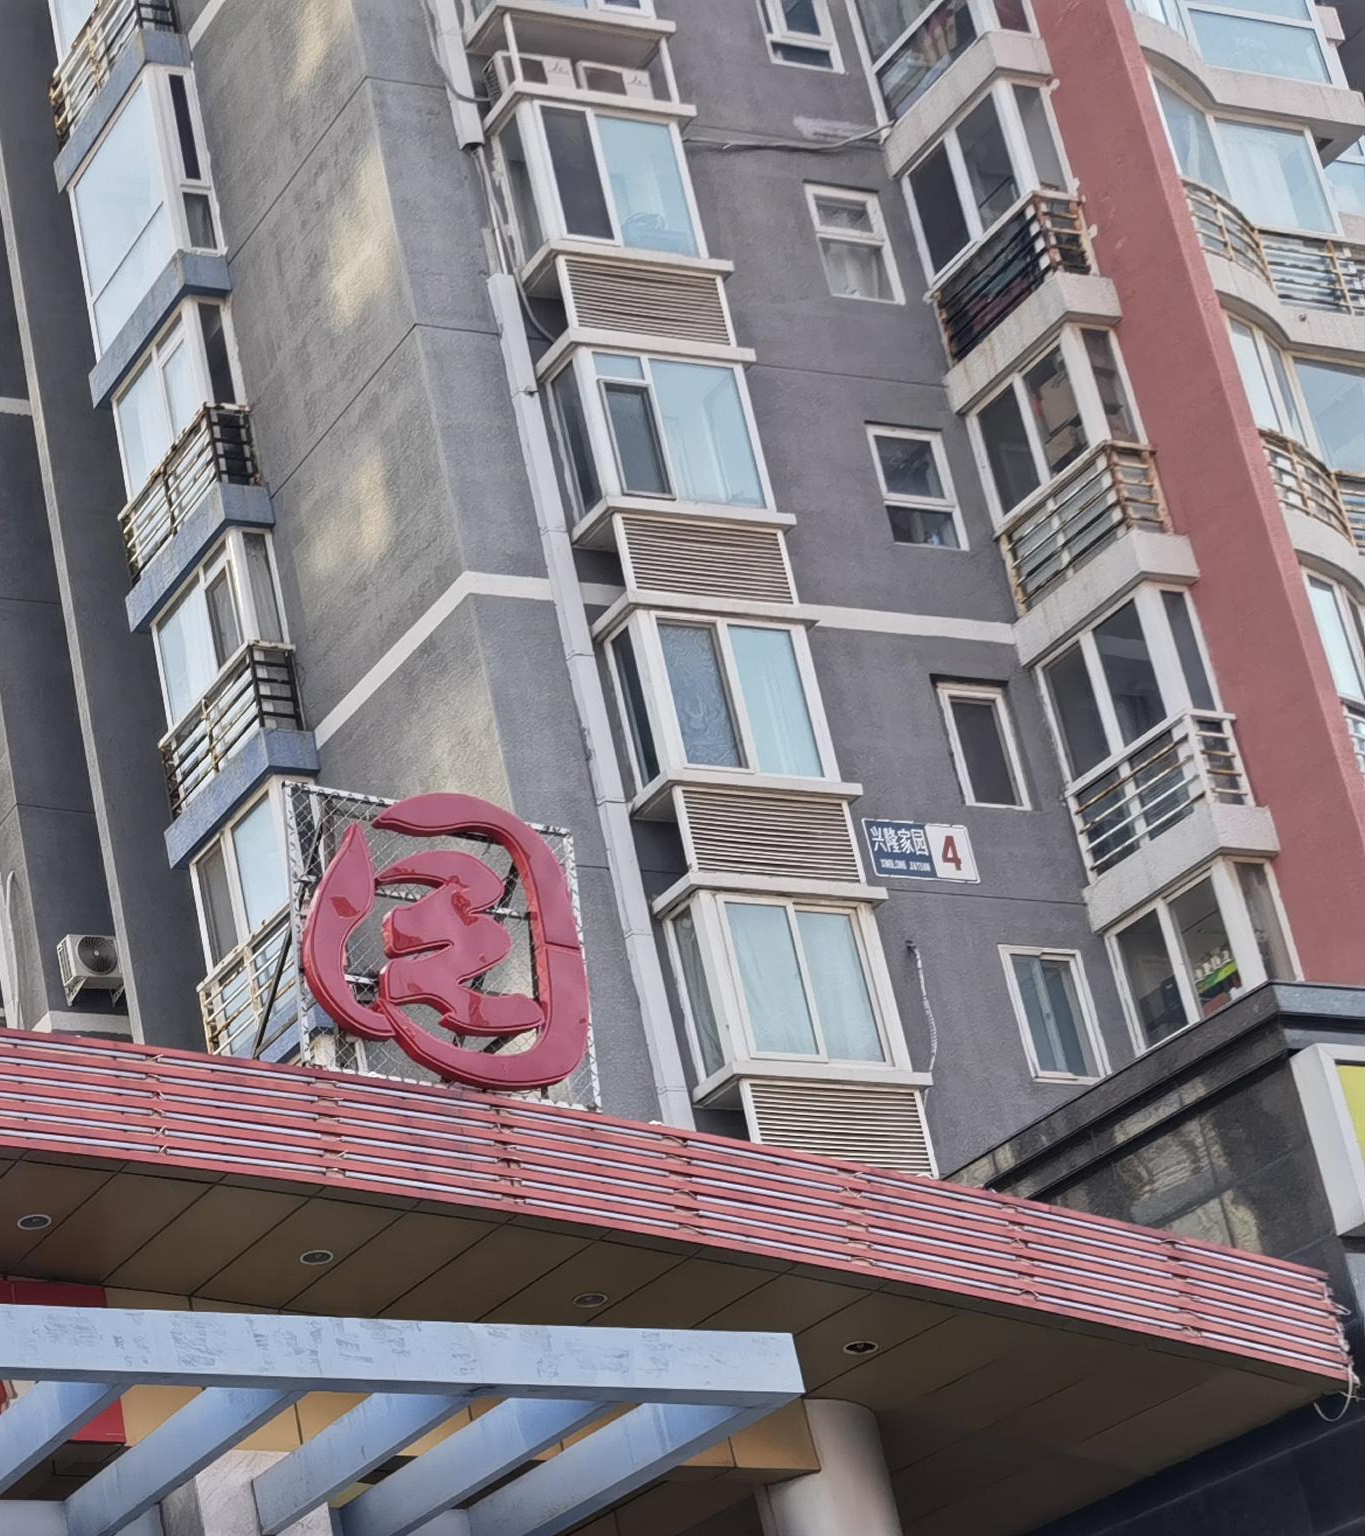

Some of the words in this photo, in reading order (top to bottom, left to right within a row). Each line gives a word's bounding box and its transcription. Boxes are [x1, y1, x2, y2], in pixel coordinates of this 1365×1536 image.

[870, 826, 929, 856] 兴隆家园
[941, 835, 962, 872] 4
